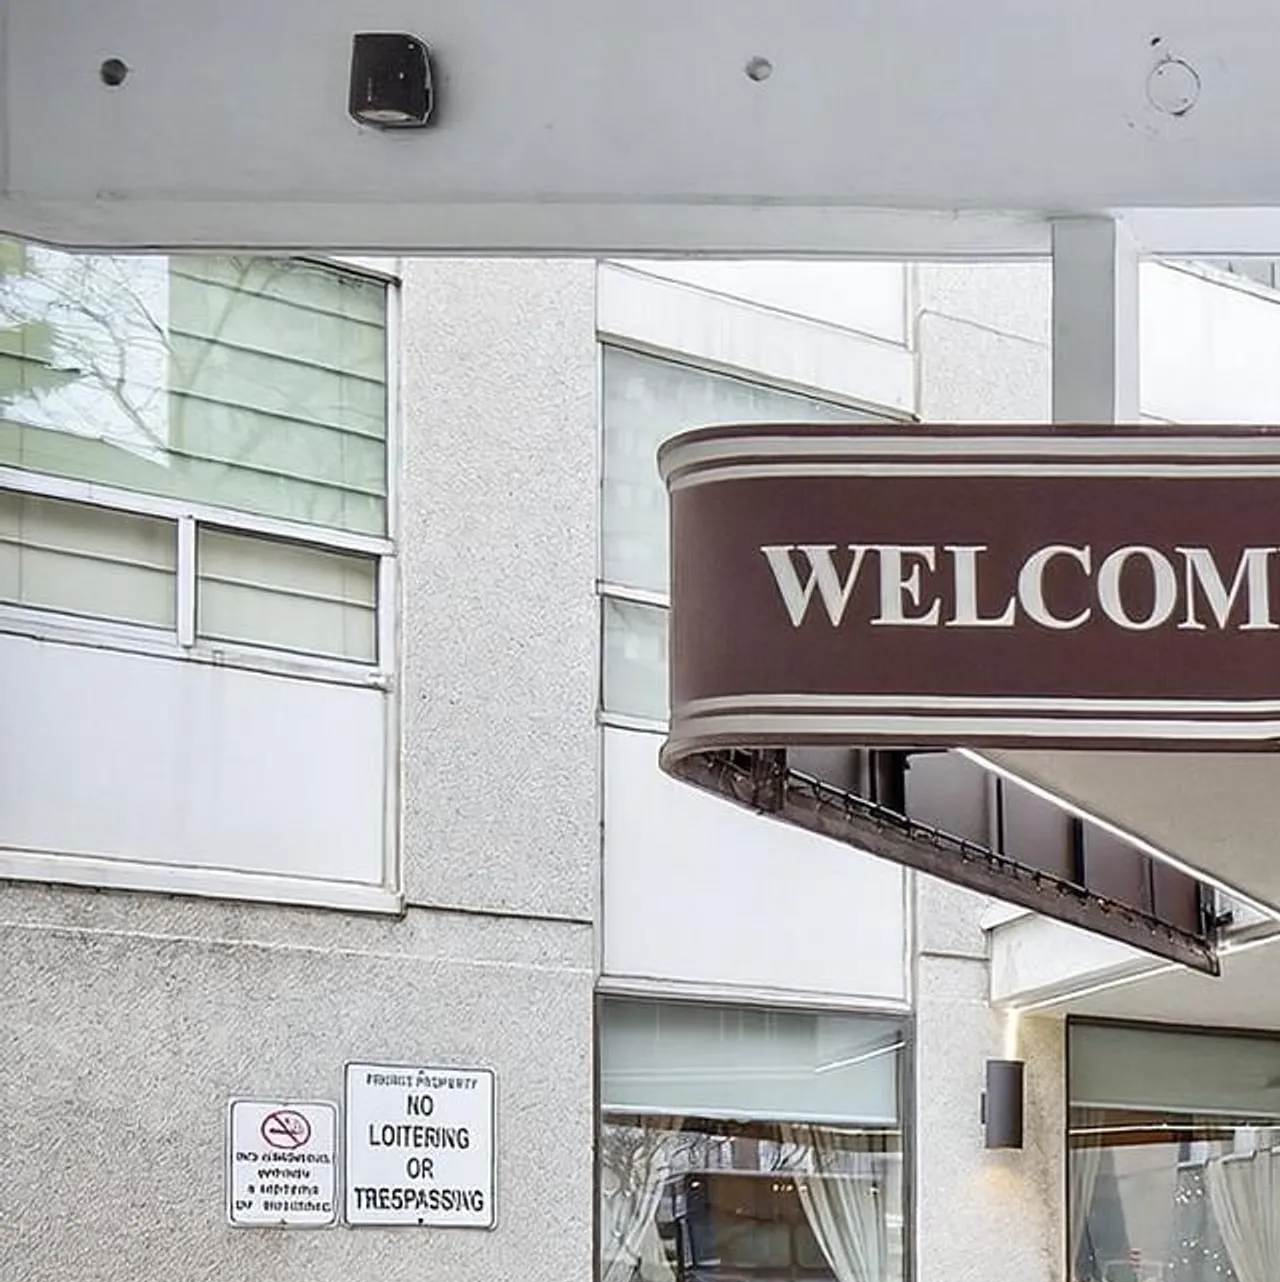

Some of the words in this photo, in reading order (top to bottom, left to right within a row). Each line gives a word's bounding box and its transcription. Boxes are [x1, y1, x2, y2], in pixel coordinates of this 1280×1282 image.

[406, 1095, 435, 1116] NO
[368, 1123, 470, 1150] LOITERING
[406, 1158, 435, 1180] OR
[353, 1186, 485, 1213] TRESPASSING
